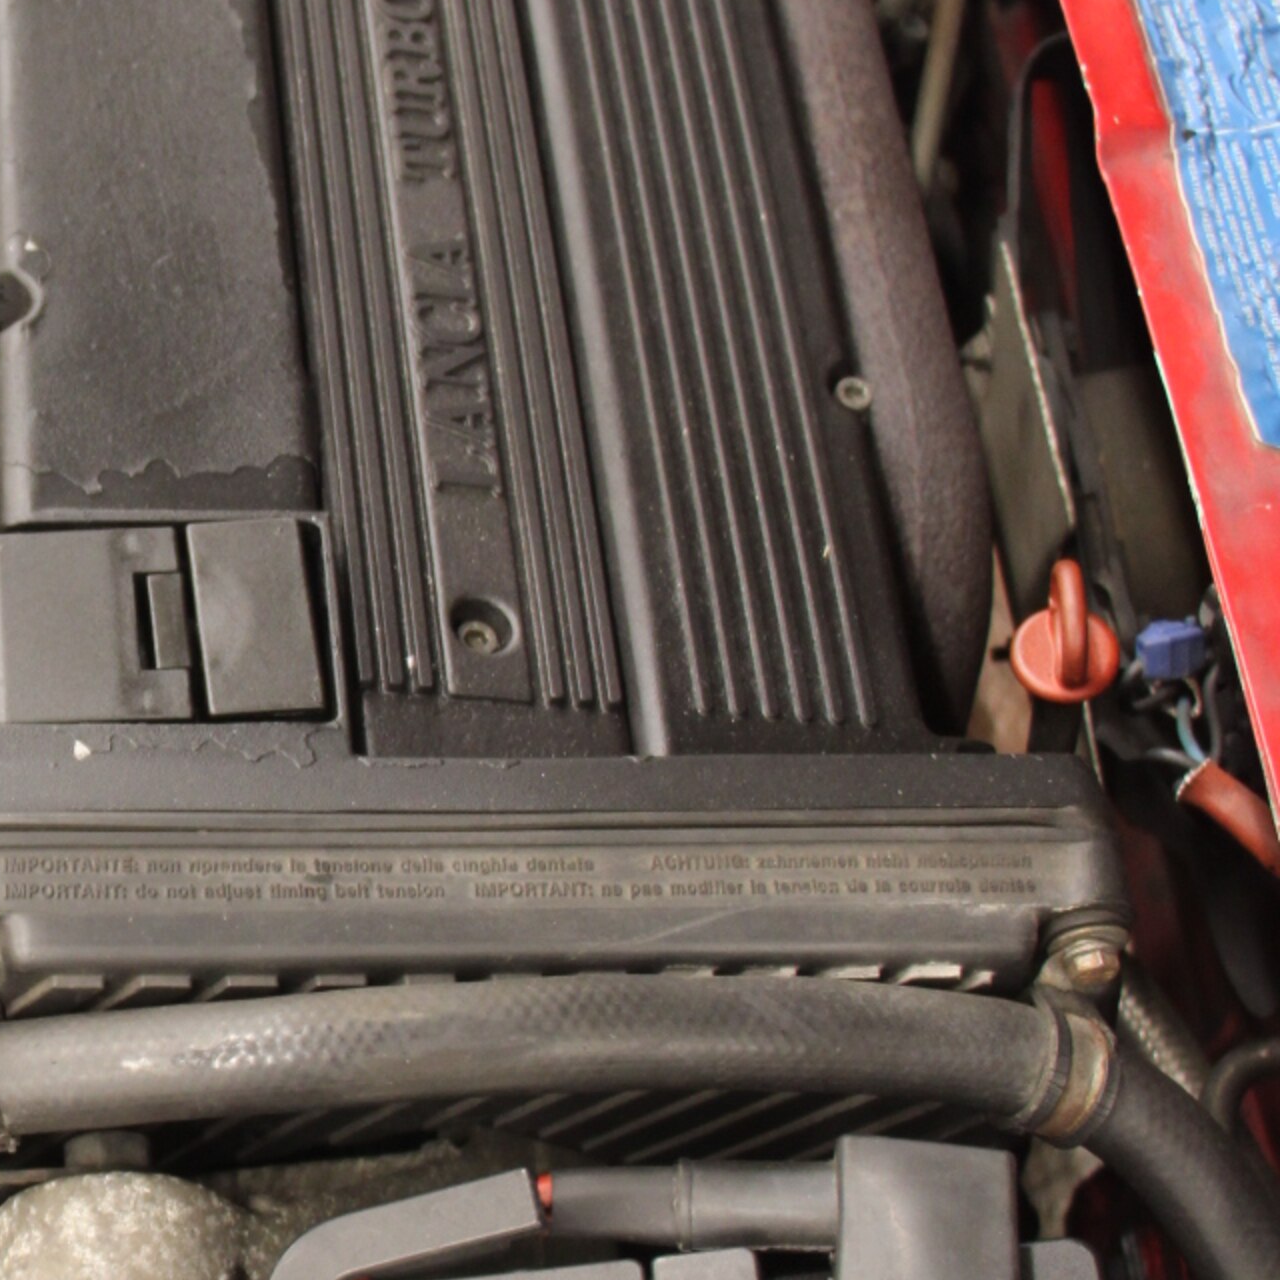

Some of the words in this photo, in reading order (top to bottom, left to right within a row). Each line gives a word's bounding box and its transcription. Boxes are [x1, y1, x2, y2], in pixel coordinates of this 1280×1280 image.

[408, 235, 502, 497] LANCIA
[5, 883, 128, 901] IMPORTANT:
[135, 883, 159, 900] do
[167, 884, 197, 900] not
[474, 881, 595, 899] IMPORTANT:
